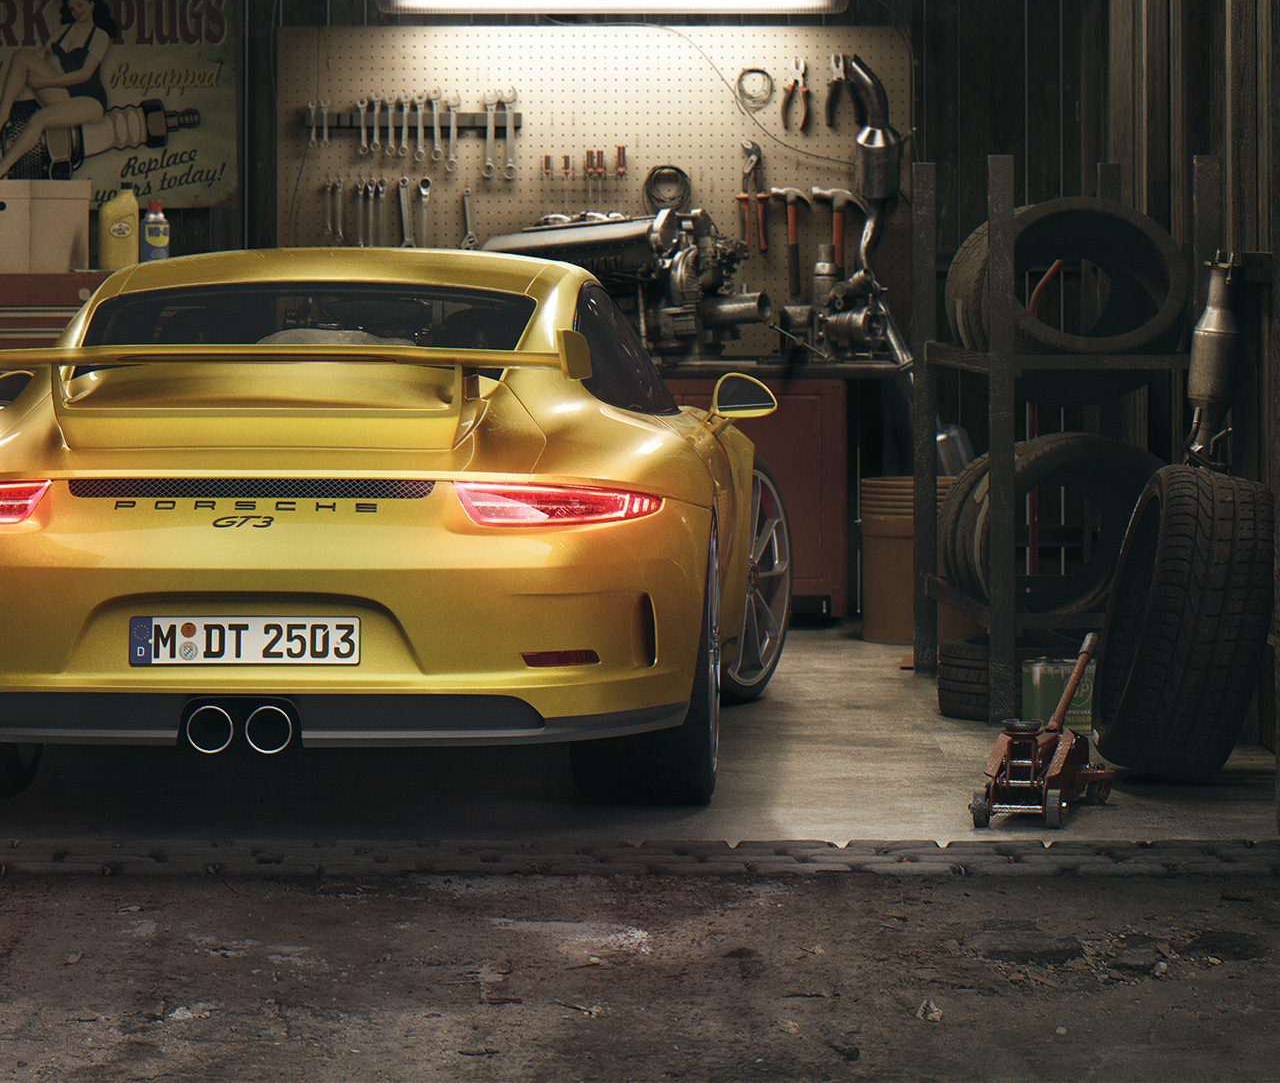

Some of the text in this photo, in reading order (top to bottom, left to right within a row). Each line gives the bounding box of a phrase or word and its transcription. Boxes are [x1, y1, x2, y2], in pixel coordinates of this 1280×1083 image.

[109, 62, 222, 97] Regapped
[120, 148, 197, 179] Replace
[92, 162, 226, 208] yors today!
[148, 226, 169, 238] WD-4
[114, 500, 378, 514] PORSCHE
[212, 515, 275, 528] GT3
[152, 623, 356, 659] M DT 2503
[137, 646, 146, 657] D
[1064, 715, 1092, 724] NERGO
